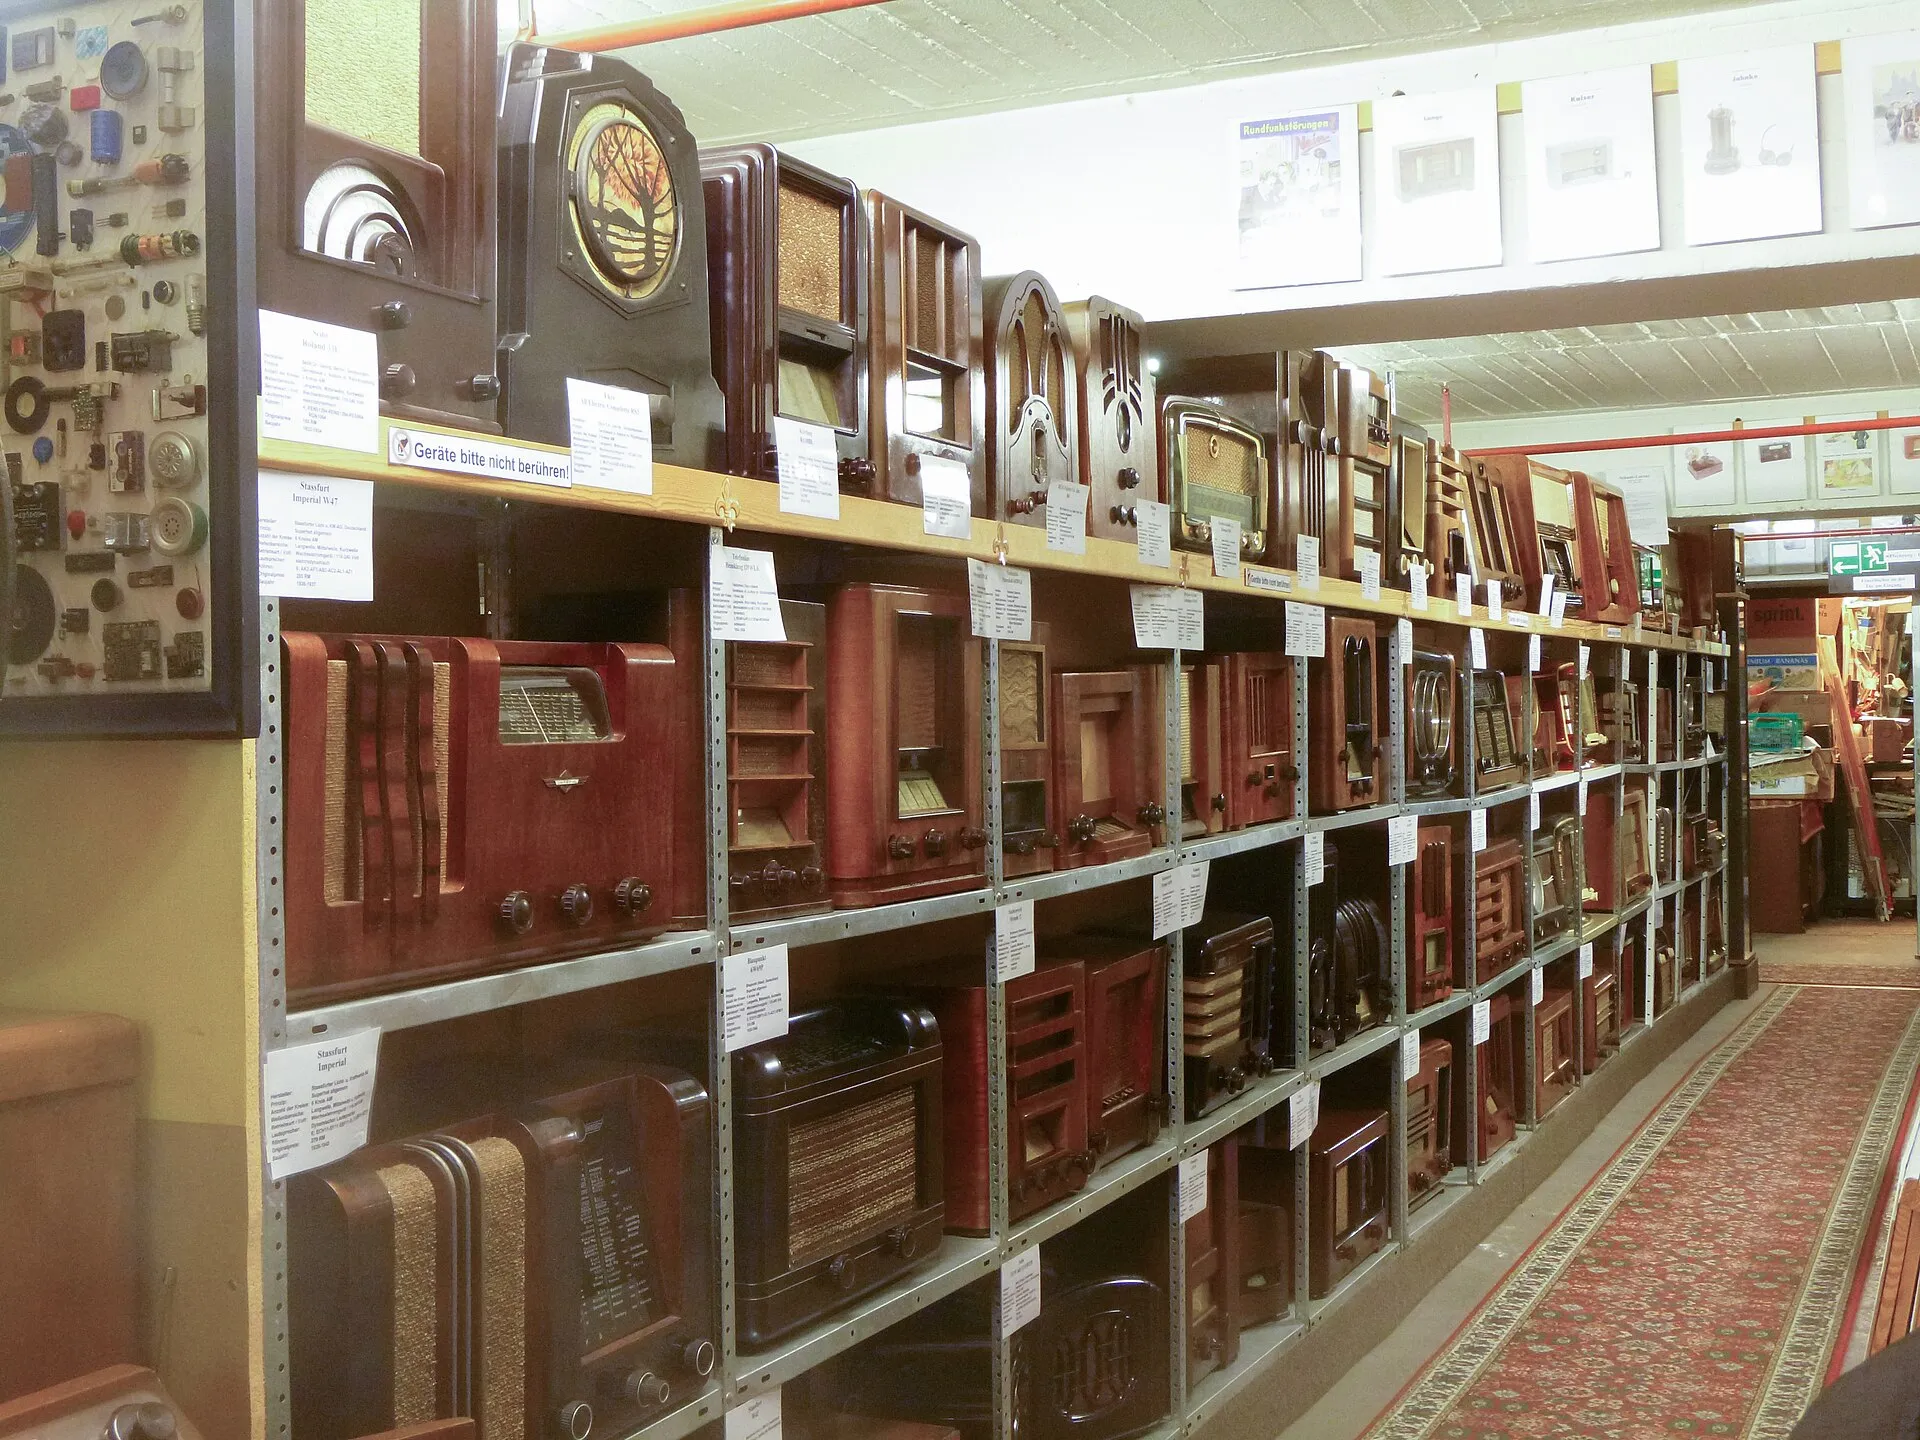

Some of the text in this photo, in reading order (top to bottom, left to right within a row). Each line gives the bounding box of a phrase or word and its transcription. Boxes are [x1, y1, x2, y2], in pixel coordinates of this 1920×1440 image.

[1243, 120, 1329, 135] Rundfunkstörungen
[414, 442, 570, 480] Geräte bitte nicht berühren!
[300, 481, 330, 493] Stassfurt
[292, 493, 338, 506] Imperial W47
[1776, 657, 1809, 665] BANANAS
[318, 1046, 348, 1058] Stassfurt
[318, 1057, 347, 1072] Imperial
